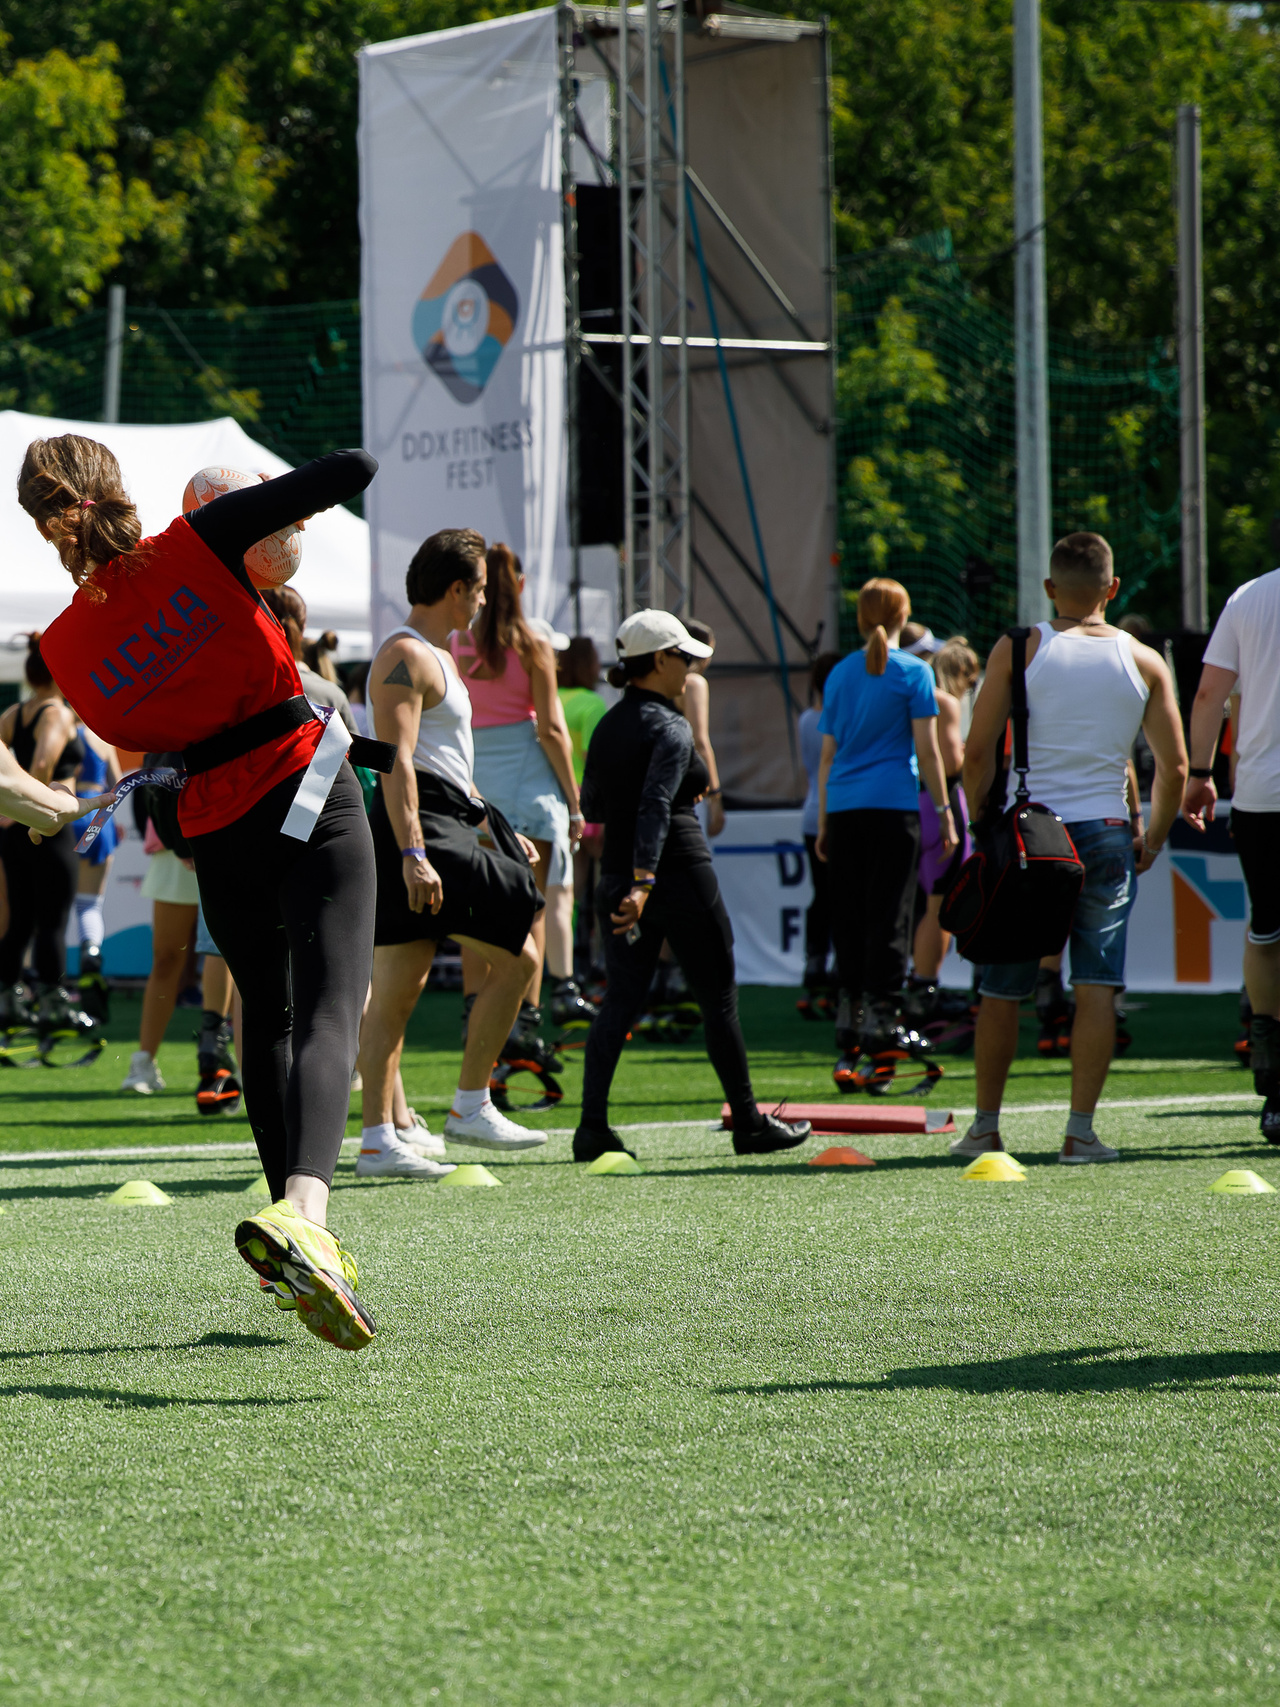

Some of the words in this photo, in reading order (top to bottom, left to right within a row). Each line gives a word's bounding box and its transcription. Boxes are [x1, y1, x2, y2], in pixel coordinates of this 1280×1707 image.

[446, 457, 494, 490] FEST
[89, 585, 209, 700] ЦСКА
[141, 611, 219, 685] РЕГБИ-КЛУБ
